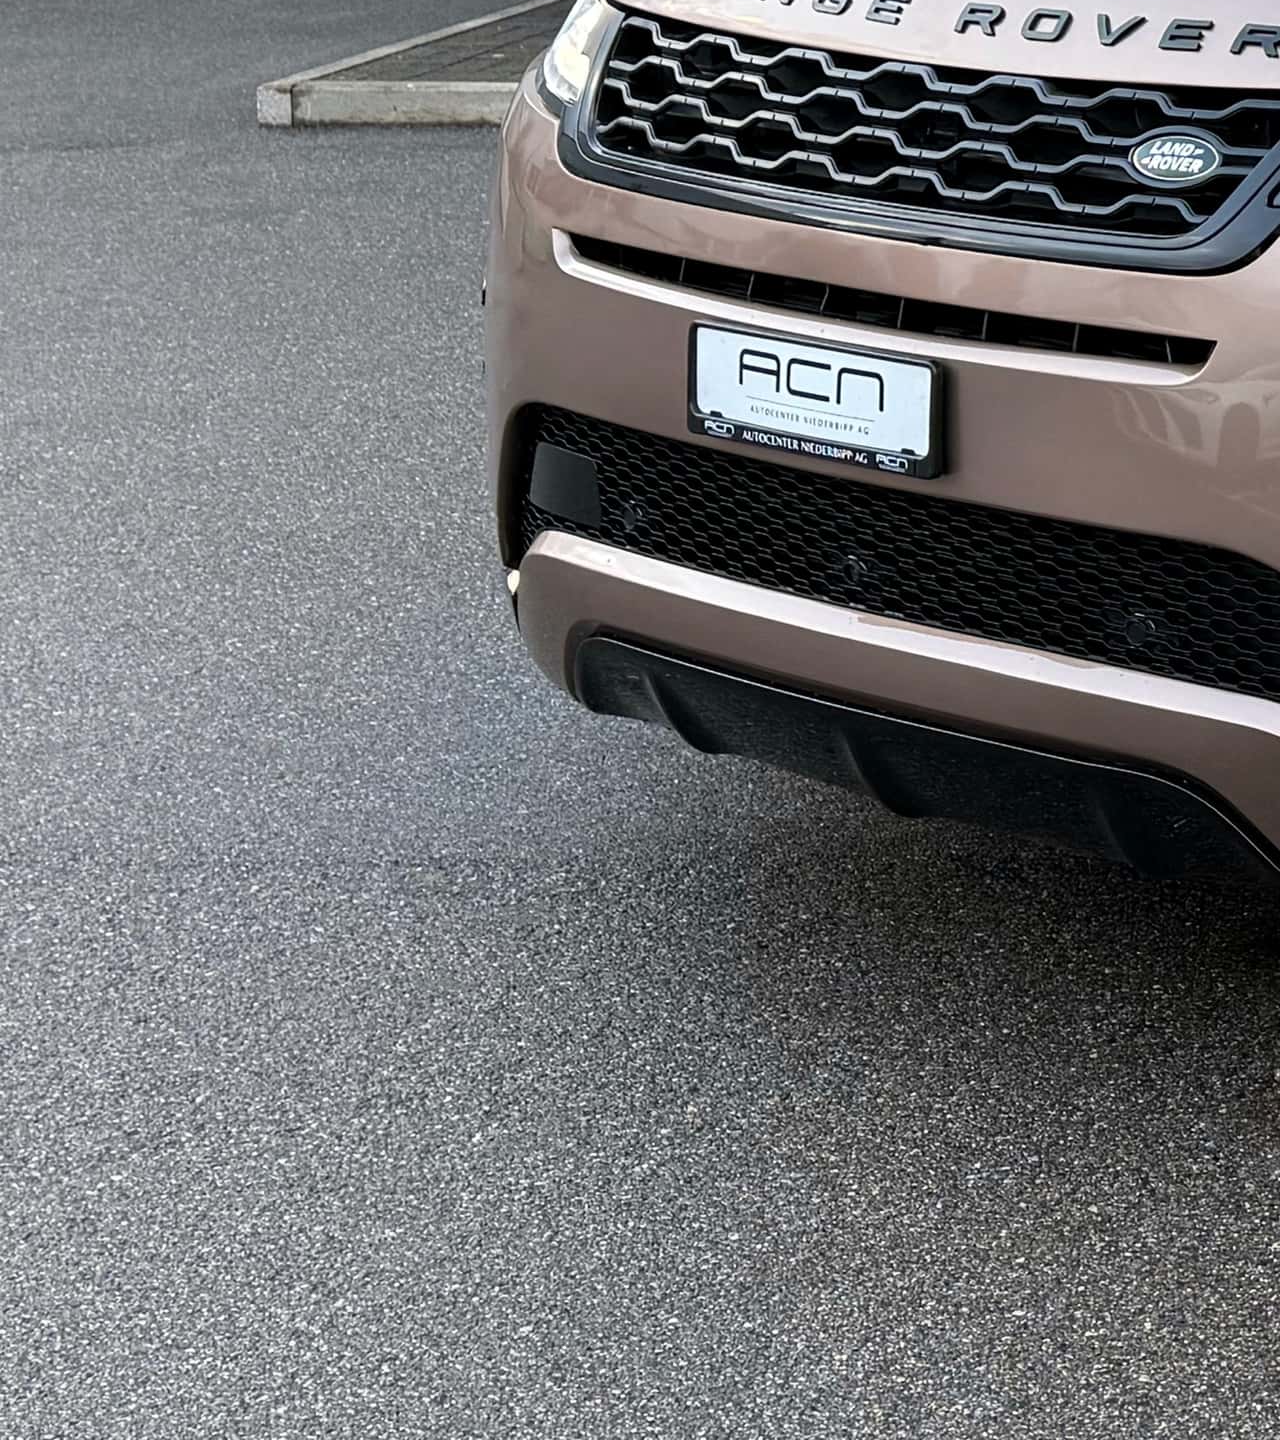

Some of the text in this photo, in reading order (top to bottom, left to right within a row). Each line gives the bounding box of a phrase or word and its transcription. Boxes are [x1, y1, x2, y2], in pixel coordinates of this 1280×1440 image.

[1149, 141, 1196, 156] LAND
[1147, 154, 1204, 173] ROVER
[750, 405, 870, 436] AUTOCENTER NIEDERBIPP AG
[742, 430, 869, 465] AUTOCENTER NIEDERBIPP AG
